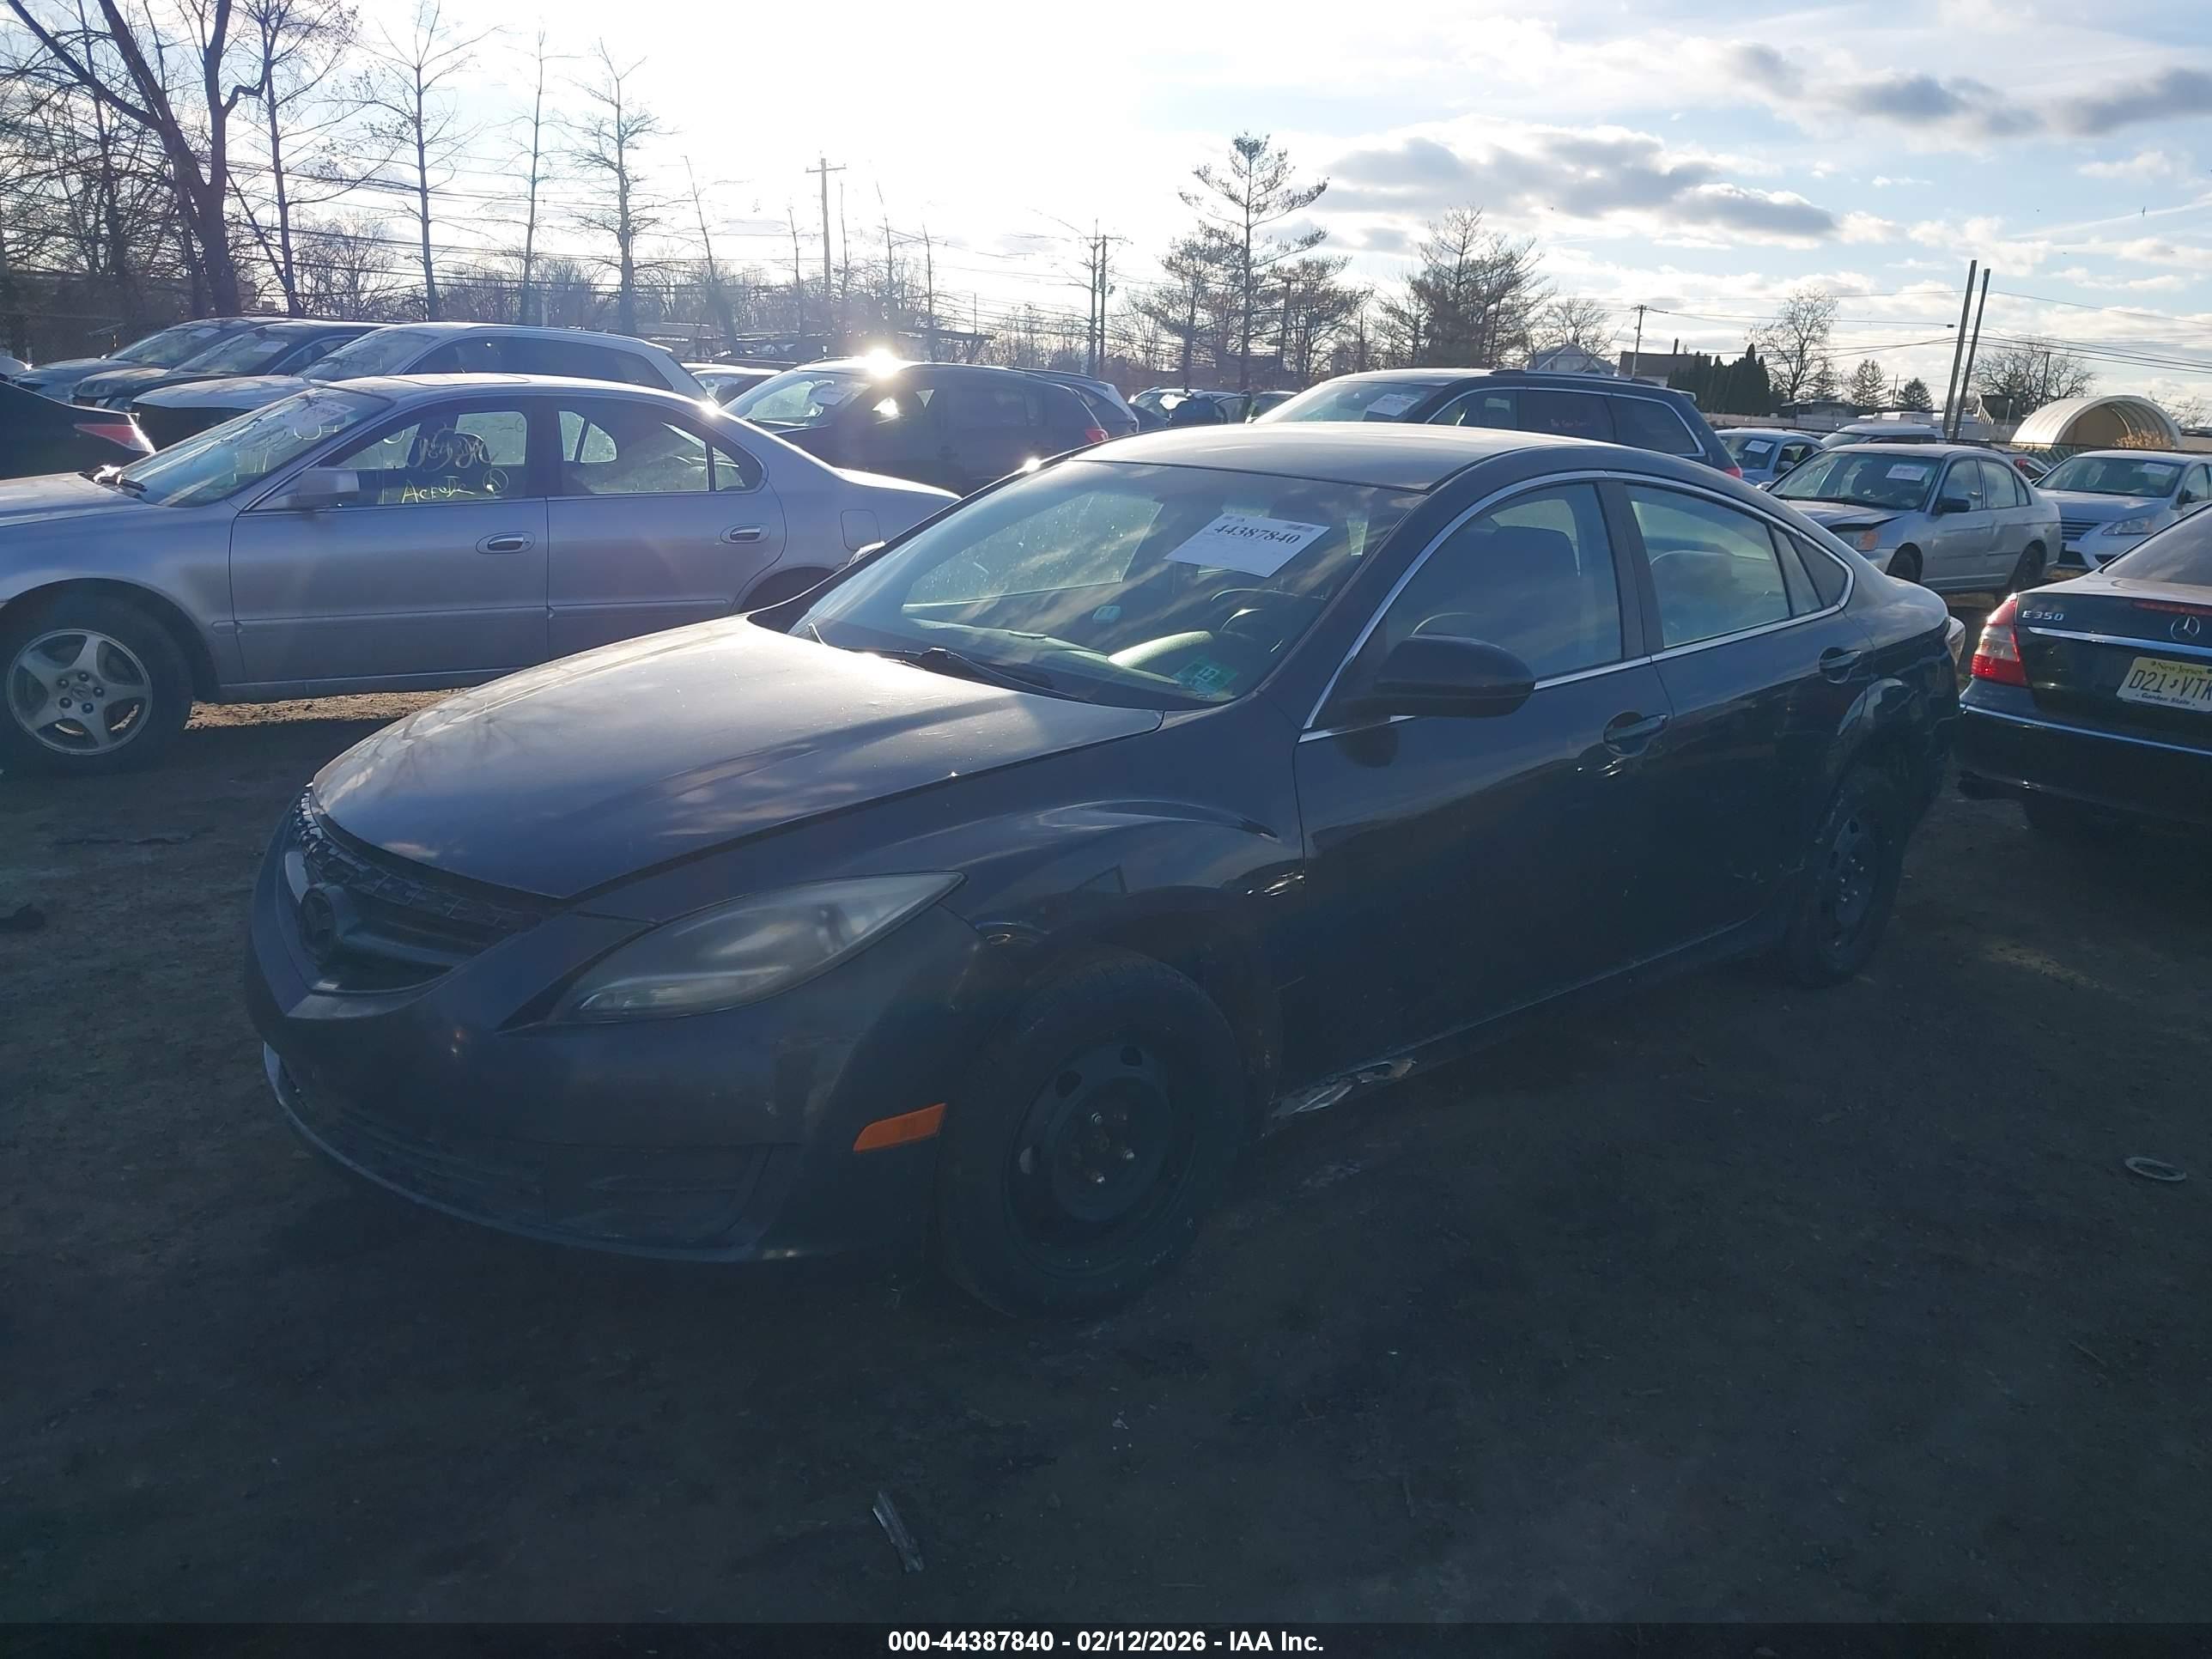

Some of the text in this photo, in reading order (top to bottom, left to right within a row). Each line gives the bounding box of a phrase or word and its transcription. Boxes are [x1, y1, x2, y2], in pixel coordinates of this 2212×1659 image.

[1213, 524, 1301, 544] 44387840
[2157, 663, 2203, 675] New Jersey
